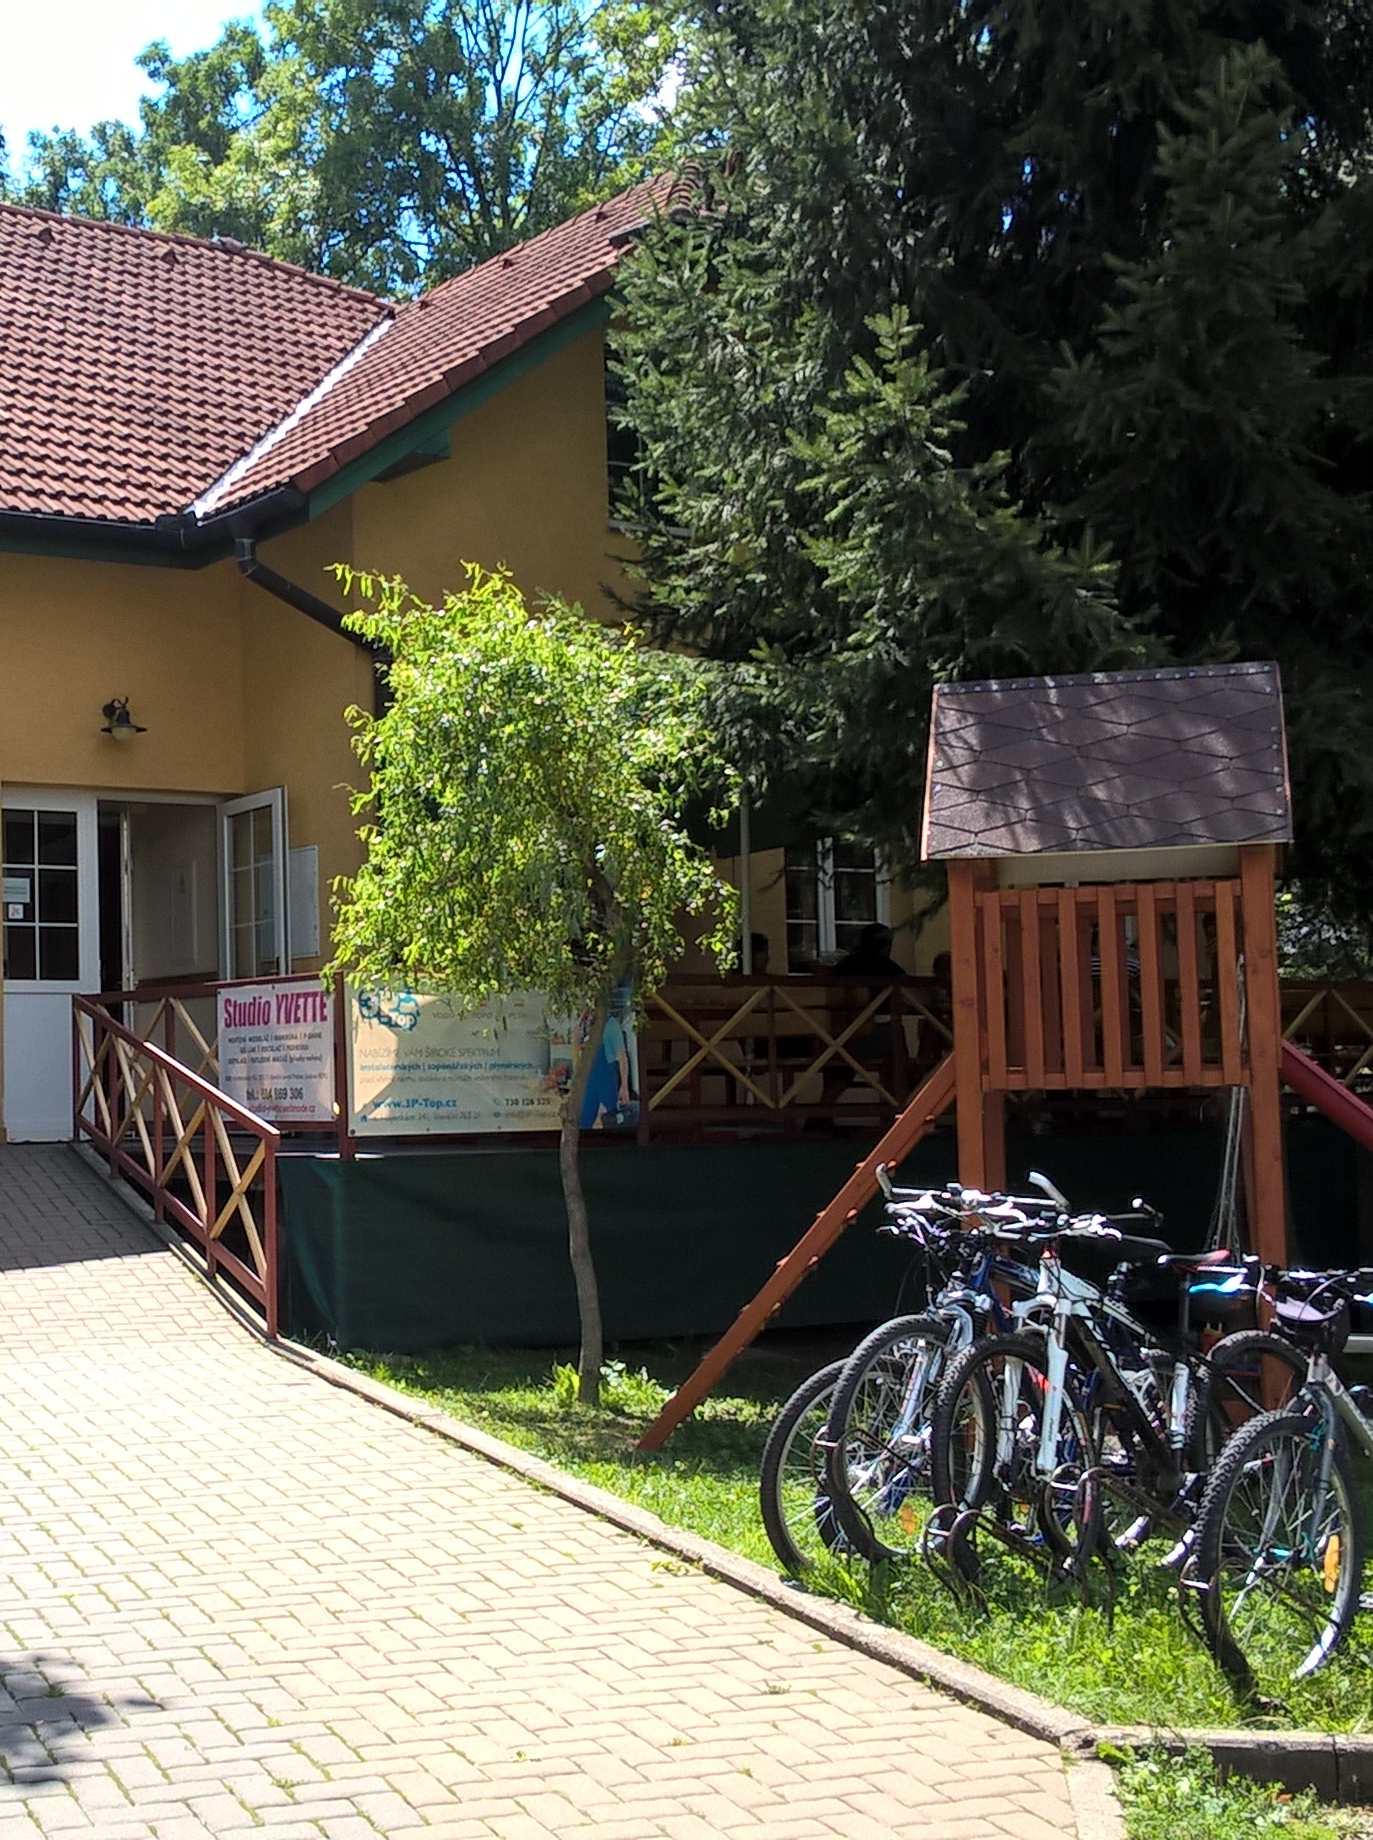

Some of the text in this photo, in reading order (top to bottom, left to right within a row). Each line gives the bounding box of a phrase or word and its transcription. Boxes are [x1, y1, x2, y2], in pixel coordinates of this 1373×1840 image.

[224, 991, 327, 1028] Studio YVETTE
[373, 1097, 457, 1108] www.3P-Top.cz
